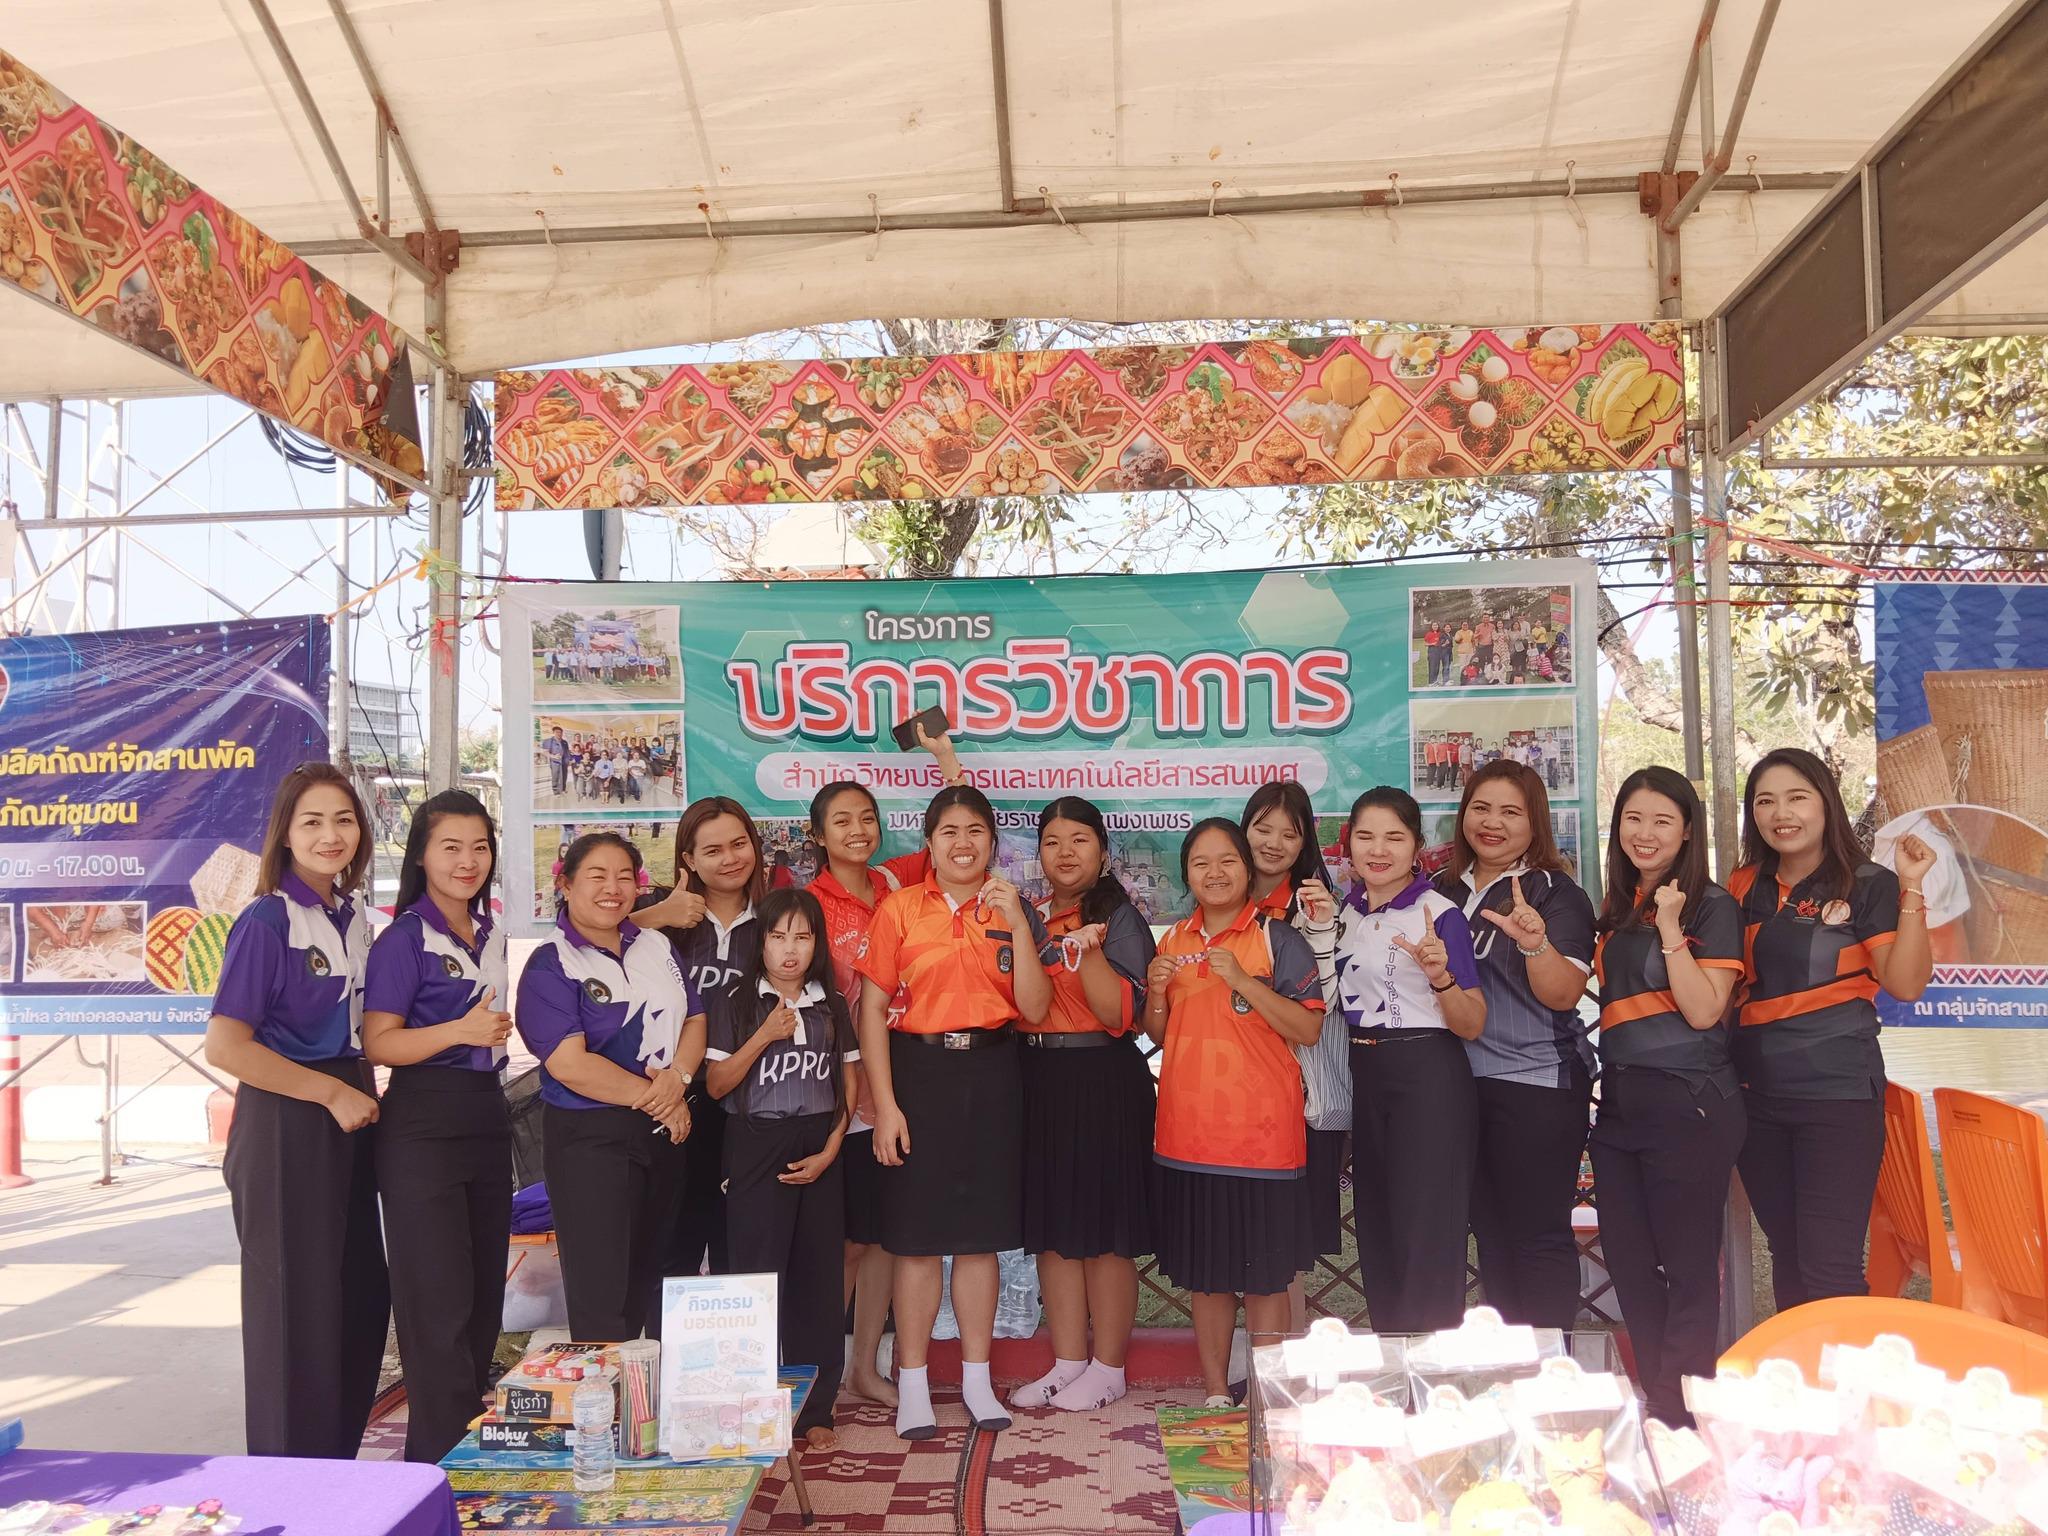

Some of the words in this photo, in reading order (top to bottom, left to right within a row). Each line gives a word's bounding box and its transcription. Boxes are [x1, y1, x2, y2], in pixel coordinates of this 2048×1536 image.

[865, 610, 992, 641] โครงการ
[727, 638, 1350, 739] บริการวิชาการ
[783, 759, 1299, 790] สำนักวิทยบริารและเทคโนโลยีสารสนเทศ
[54, 855, 118, 877] 17.00
[121, 856, 144, 877] น.
[834, 930, 859, 946] HUSO
[1914, 1000, 1933, 1016] ณ
[759, 1050, 831, 1086] KPRU
[687, 1295, 753, 1312] กิจกรรม
[683, 1312, 758, 1330] บอร์ดเกม
[510, 1393, 547, 1416] ยูเรก้า
[482, 1425, 529, 1442] Blokus
